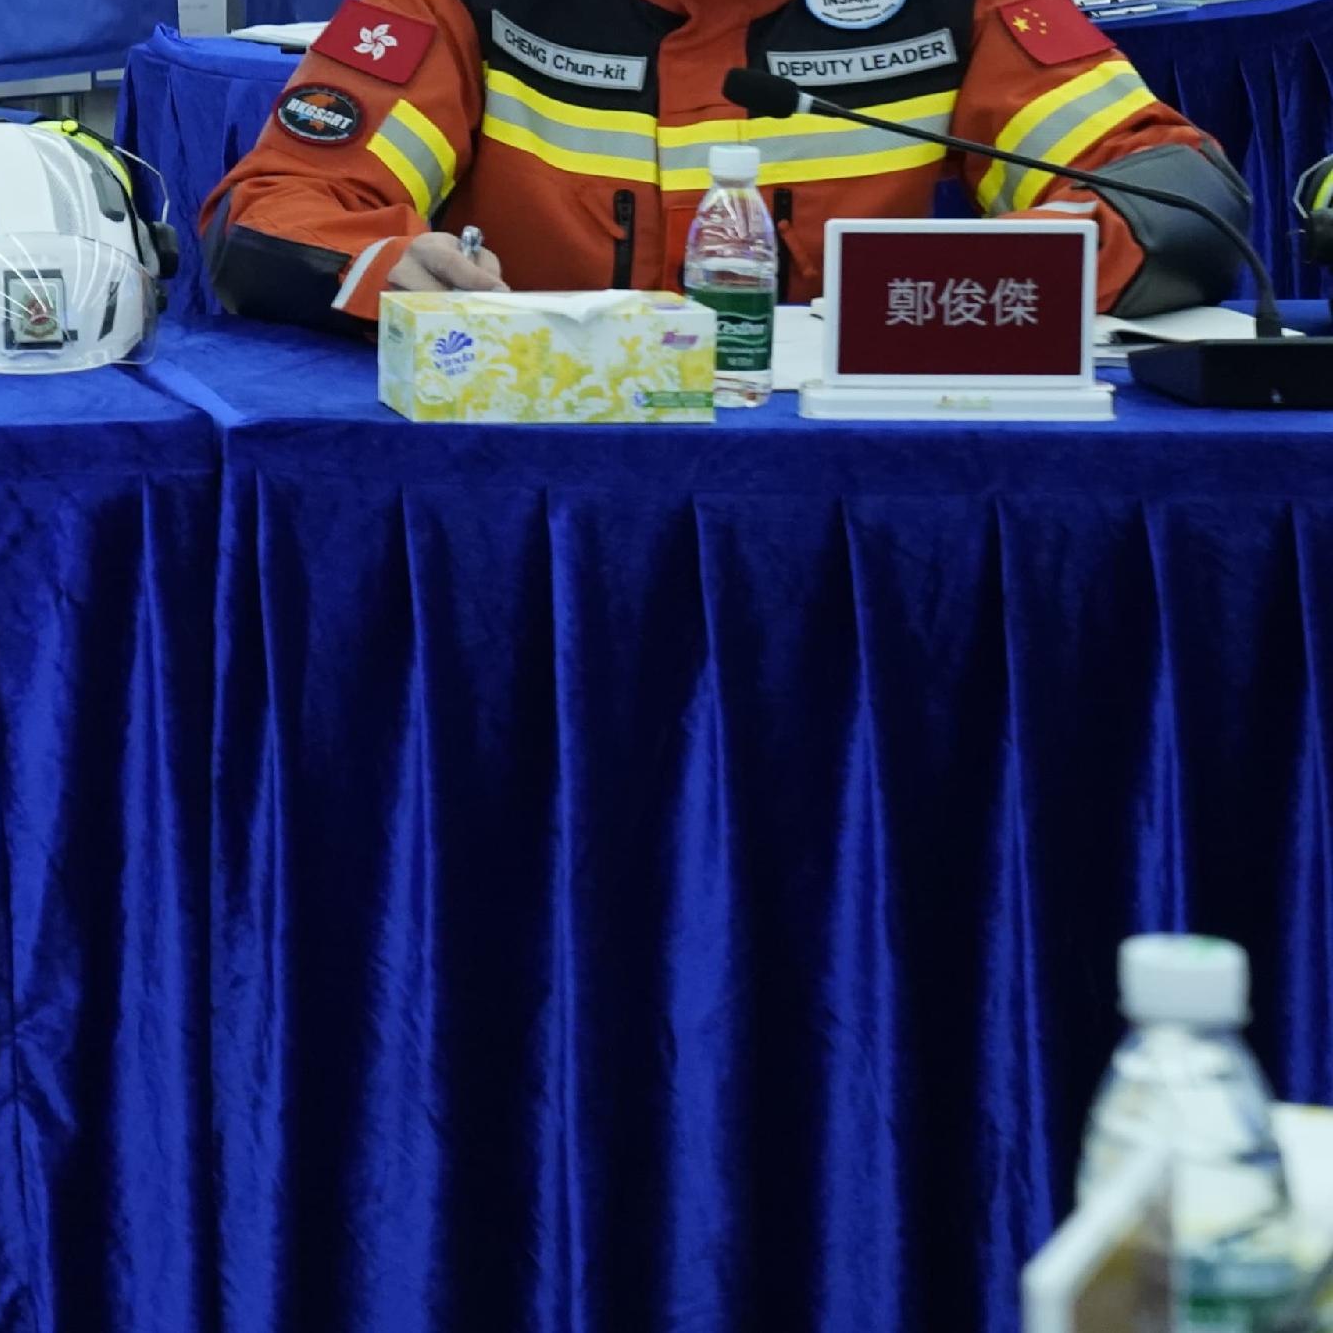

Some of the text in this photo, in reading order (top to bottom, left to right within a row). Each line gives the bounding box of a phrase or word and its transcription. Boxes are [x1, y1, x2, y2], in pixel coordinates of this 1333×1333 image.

[504, 29, 627, 81] CHENG Chun-kit
[777, 41, 947, 77] DEPUTY LEADER
[885, 278, 1040, 327] 鄭俊傑
